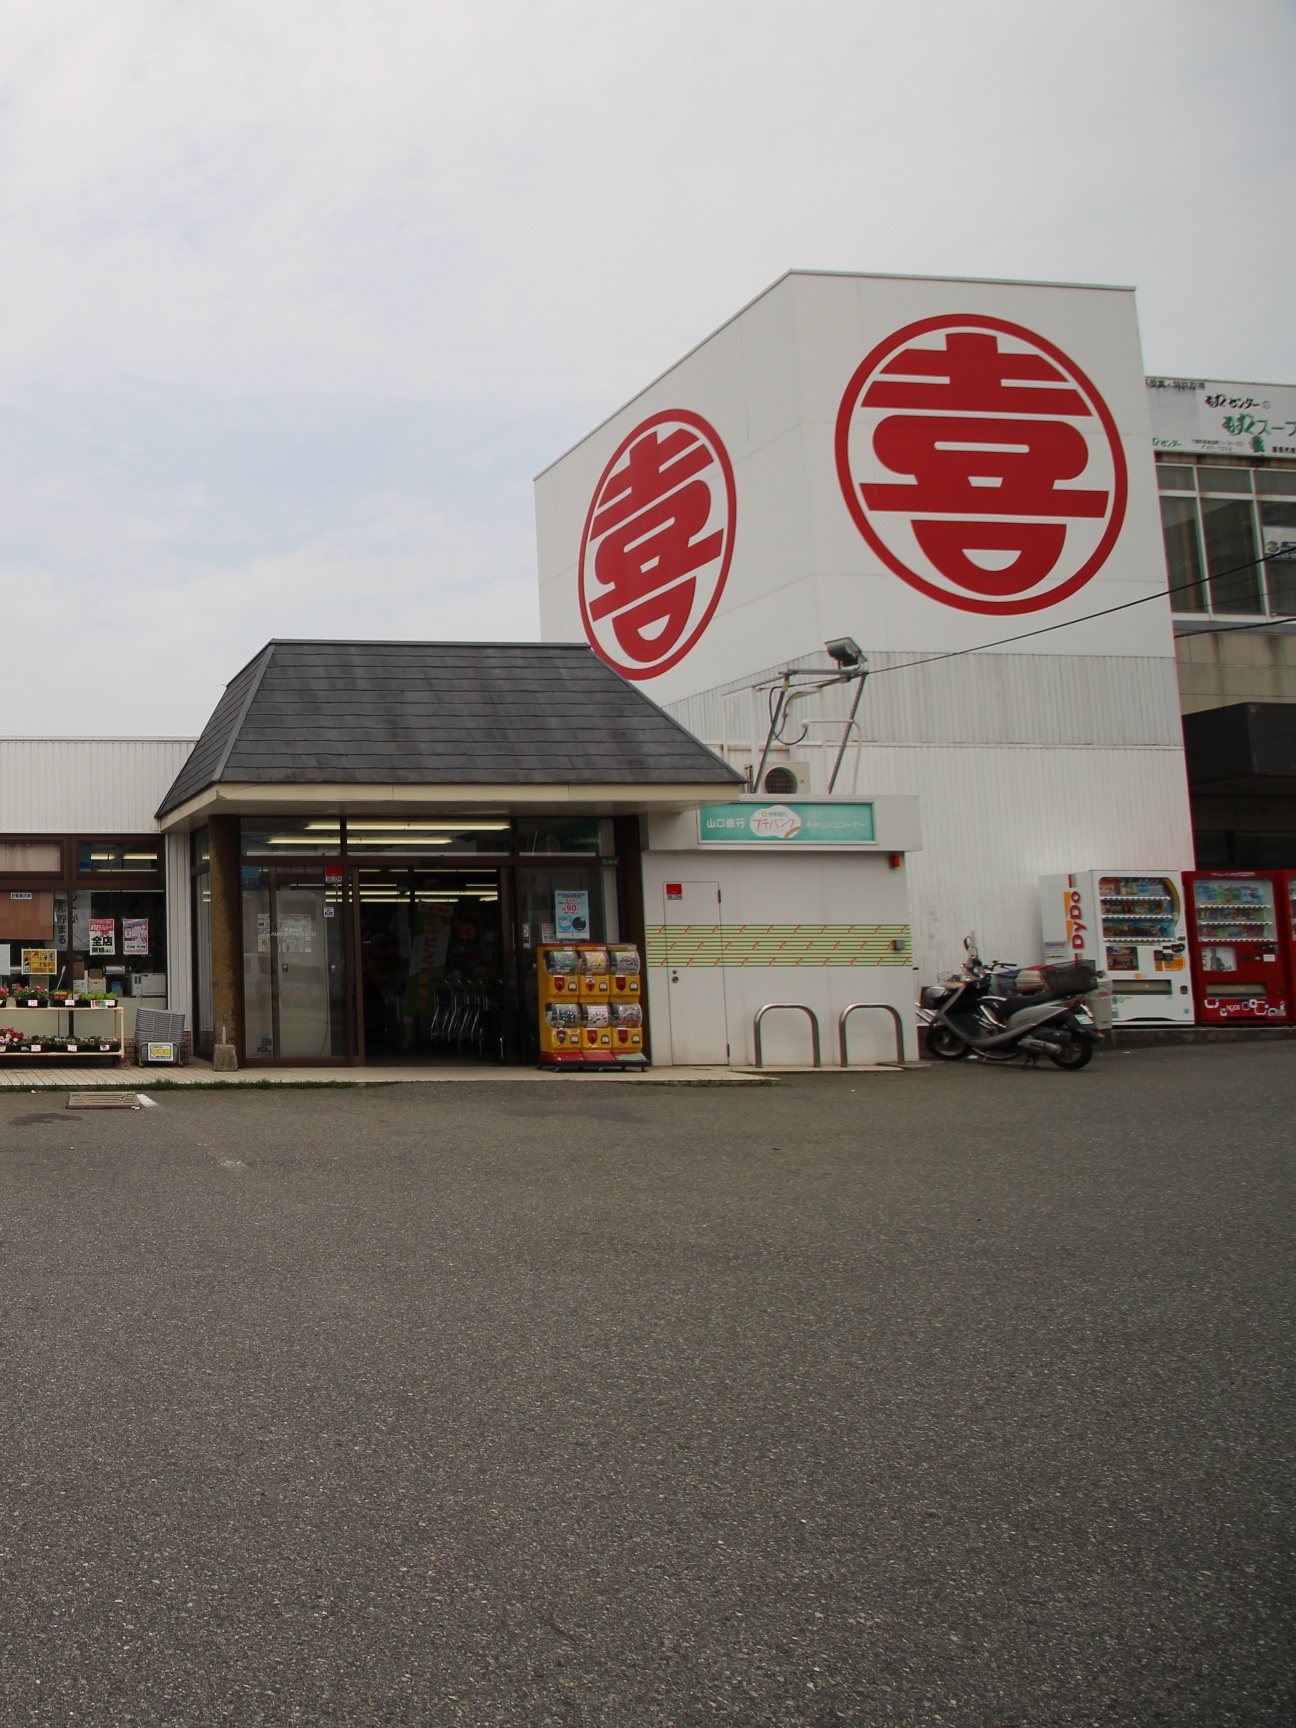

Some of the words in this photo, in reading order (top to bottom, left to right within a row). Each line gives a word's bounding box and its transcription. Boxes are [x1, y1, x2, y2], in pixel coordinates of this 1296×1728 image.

[858, 331, 1109, 597] 喜
[91, 936, 113, 946] 全店
[1069, 890, 1088, 949] DyDo
